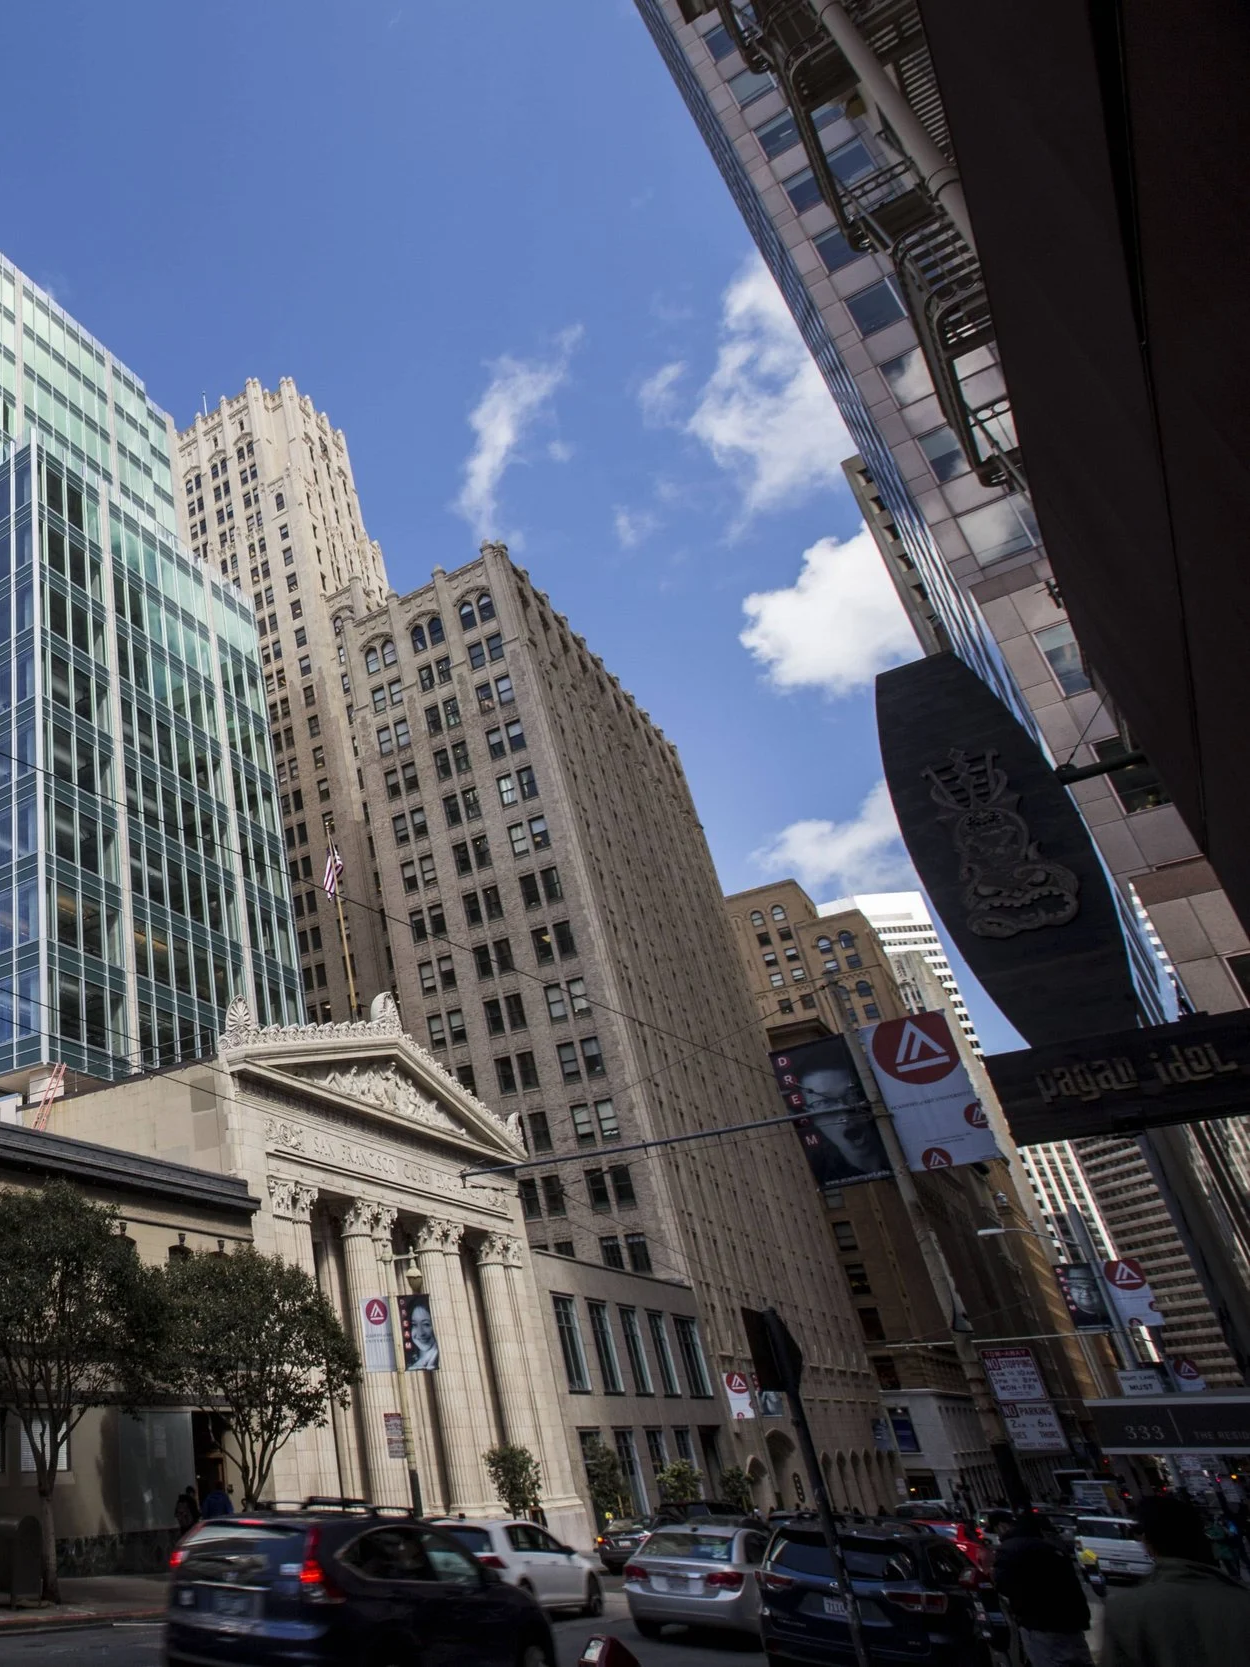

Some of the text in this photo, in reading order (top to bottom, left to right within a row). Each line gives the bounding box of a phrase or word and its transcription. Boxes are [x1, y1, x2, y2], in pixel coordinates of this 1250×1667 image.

[1037, 1056, 1139, 1104] pagan
[985, 1357, 999, 1369] NO
[1129, 1383, 1153, 1391] MUST
[1001, 1404, 1052, 1417] NO PARKING
[1125, 1425, 1165, 1440] 333
